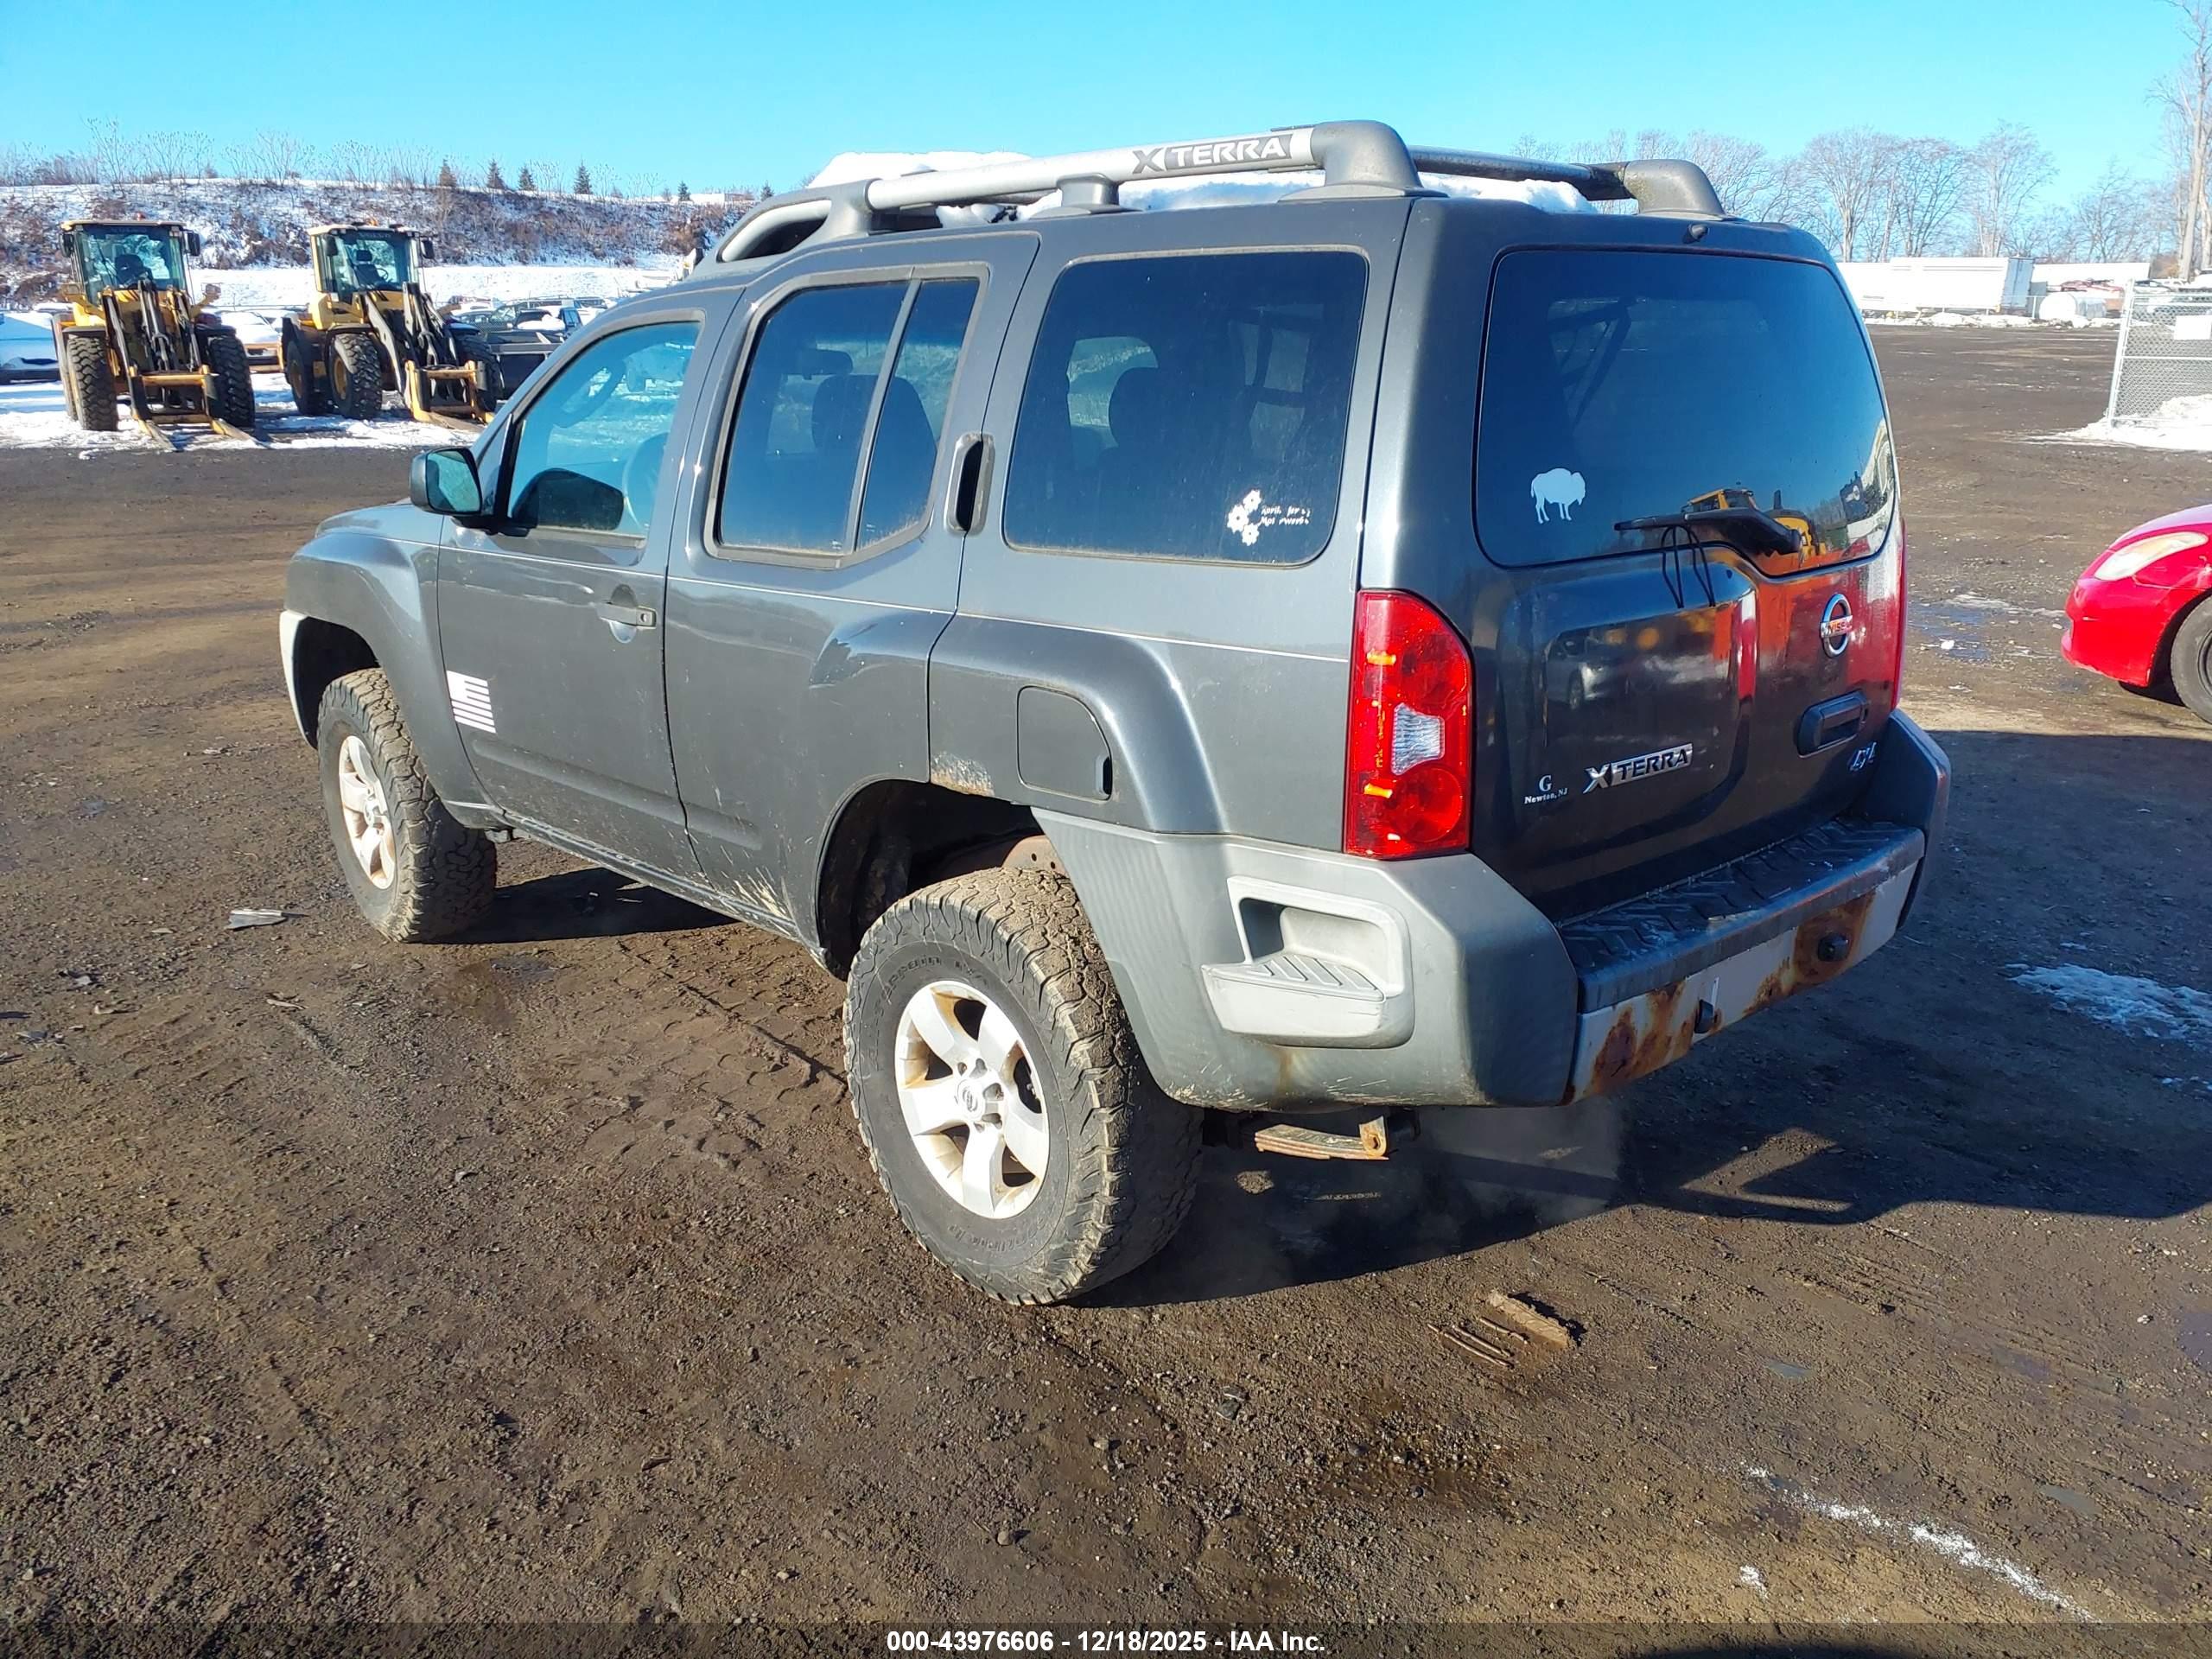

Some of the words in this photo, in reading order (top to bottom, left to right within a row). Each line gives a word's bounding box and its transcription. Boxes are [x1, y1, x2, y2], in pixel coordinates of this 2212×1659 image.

[1132, 134, 1290, 174] XTERRA
[1583, 742, 1693, 793] XTERRA
[1539, 775, 1552, 791] G
[1558, 787, 1568, 797] NJ
